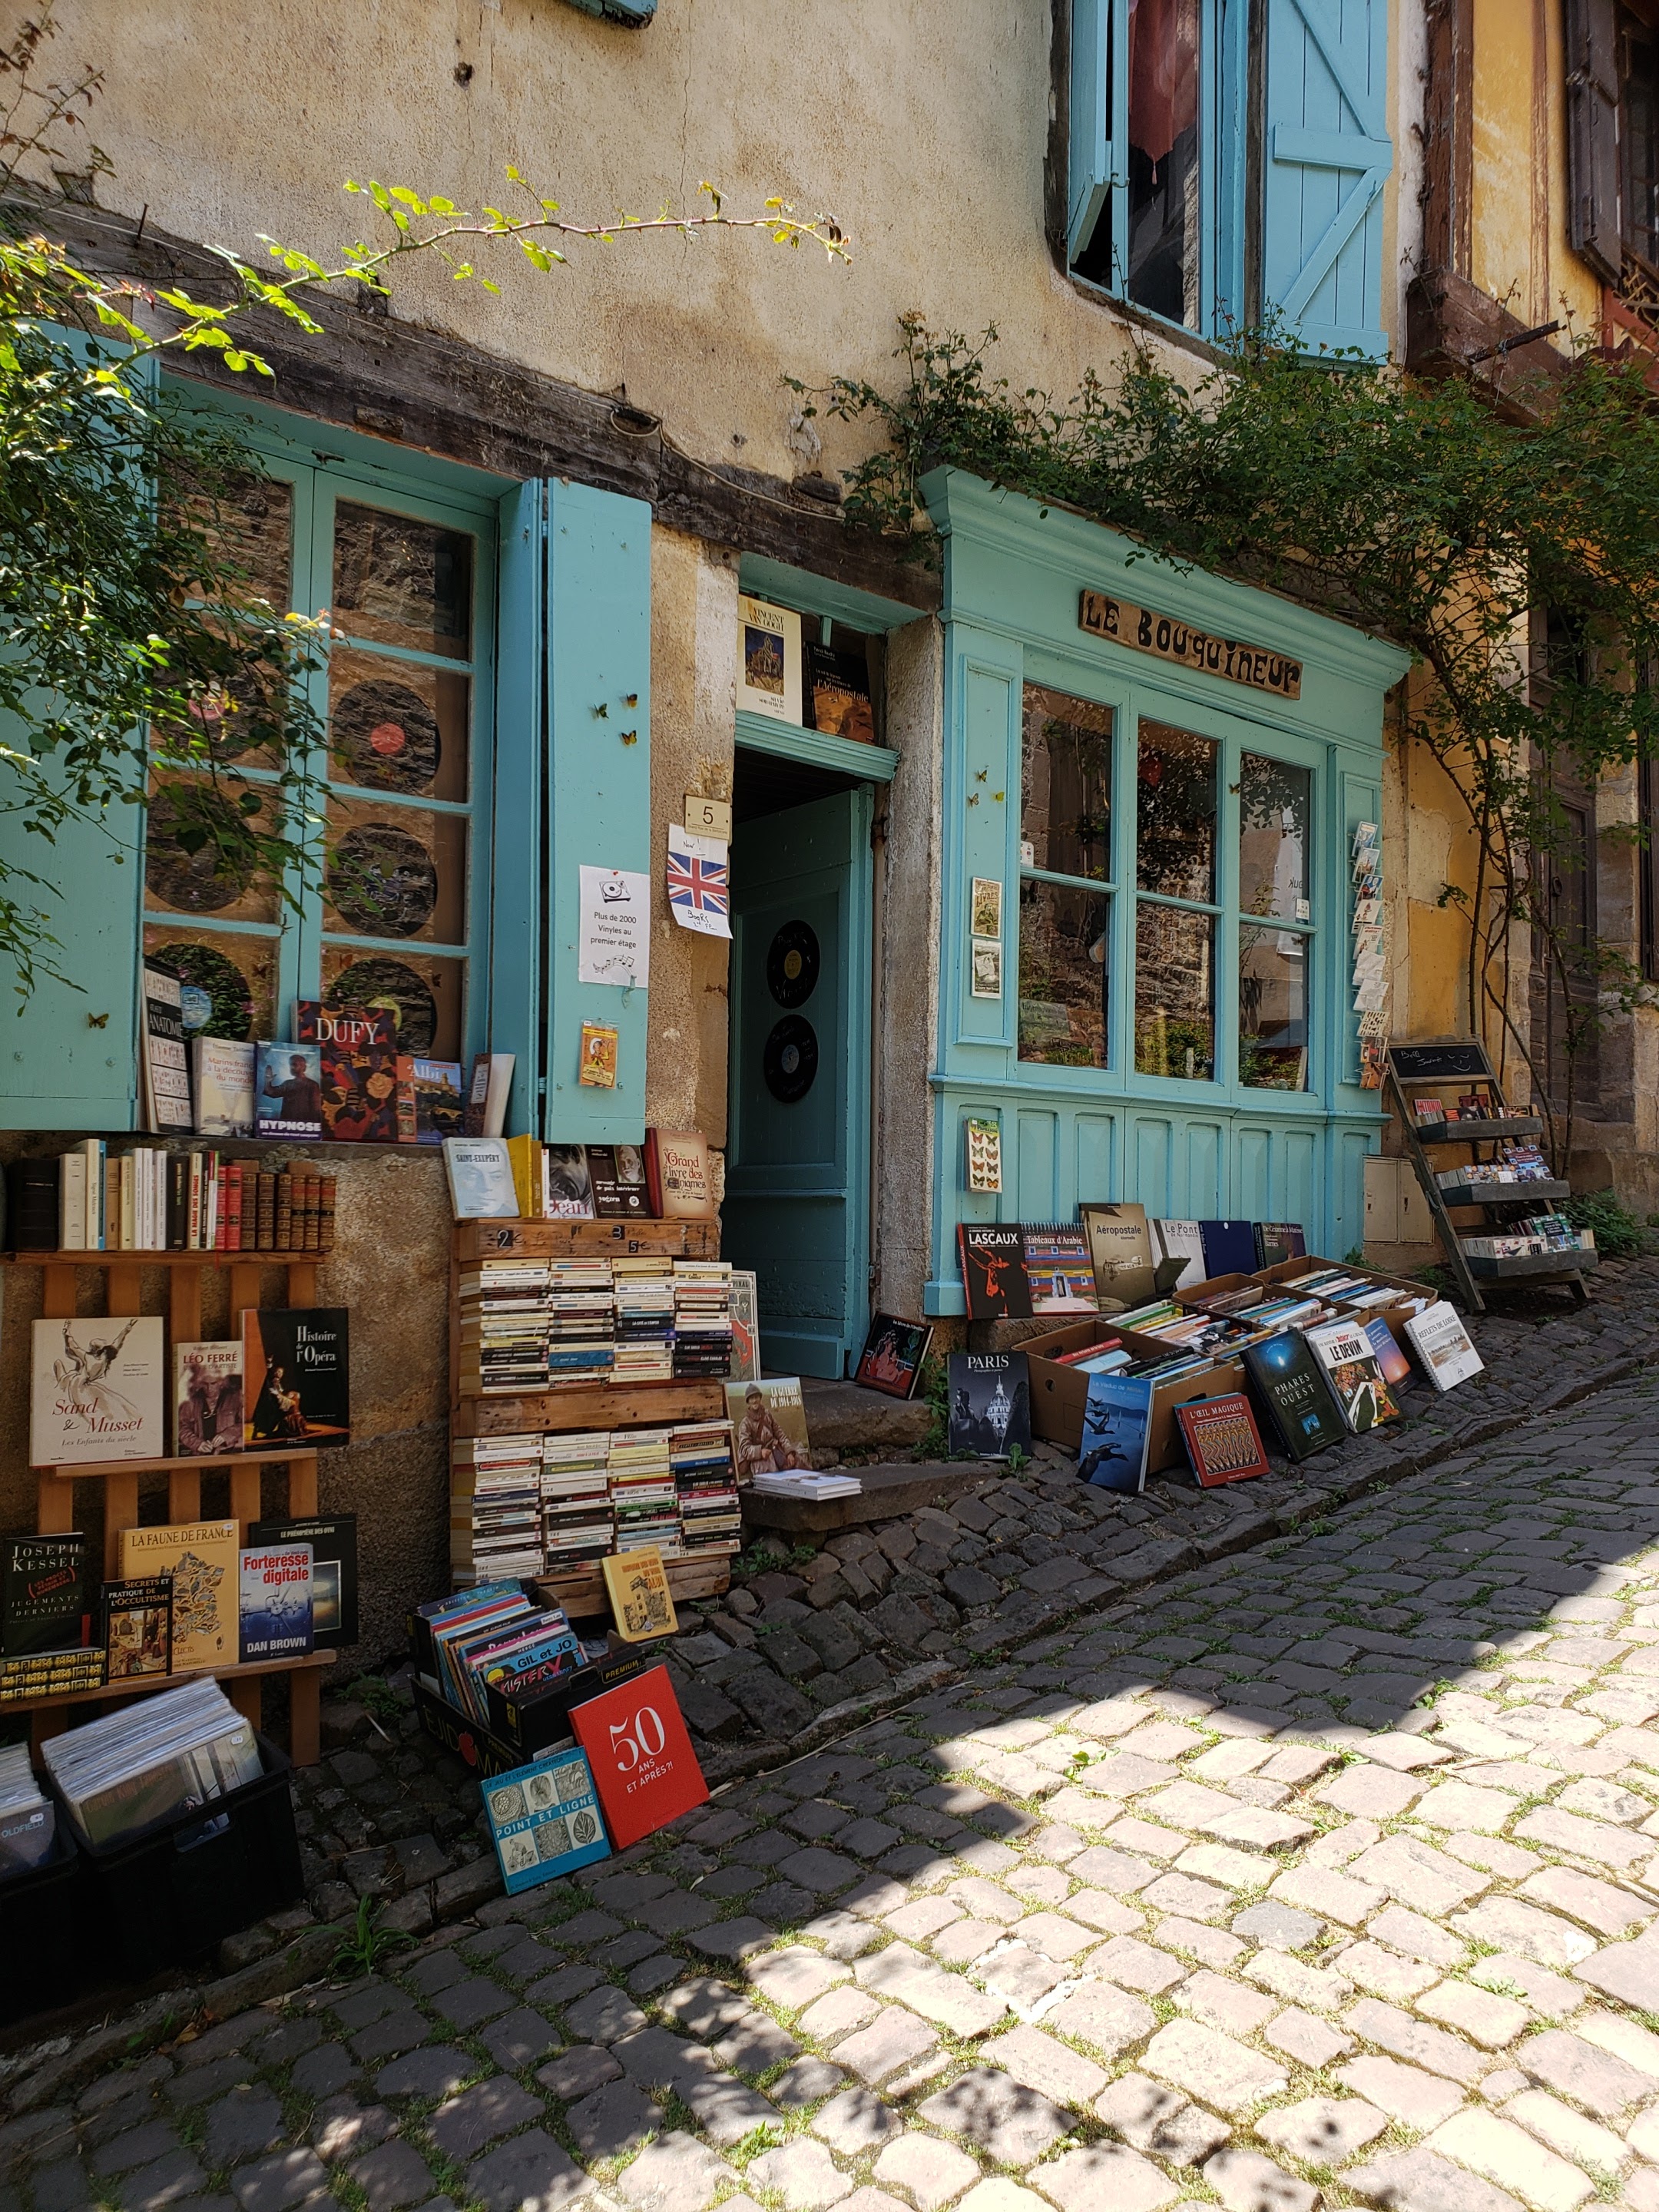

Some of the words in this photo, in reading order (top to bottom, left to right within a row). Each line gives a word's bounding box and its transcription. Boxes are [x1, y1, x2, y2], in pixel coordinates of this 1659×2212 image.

[753, 606, 785, 624] VINCENT
[1085, 594, 1120, 635] LE
[749, 613, 761, 625] VAN
[763, 618, 784, 633] GOGH
[817, 678, 869, 703] l'Aéropostale
[702, 806, 714, 825] 5
[594, 911, 608, 921] Plus
[609, 912, 618, 922] de
[619, 914, 637, 924] 2000
[598, 924, 622, 935] Vinyles
[623, 927, 632, 935] au
[591, 938, 617, 948] premier
[618, 939, 637, 949] étage
[316, 1018, 380, 1045] DUFY
[208, 1057, 233, 1066] Marins
[259, 1119, 322, 1131] HYPNOSE
[455, 1154, 501, 1163] SAINT-EXUPÉRY
[667, 1152, 700, 1167] Grand
[668, 1165, 687, 1179] livre
[688, 1167, 704, 1180] des
[191, 1174, 200, 1197] SONGES
[549, 1198, 590, 1214] Jean
[1096, 1225, 1142, 1236] Aéropostale
[1164, 1224, 1176, 1233] Le
[1177, 1224, 1198, 1235] Pont
[969, 1233, 1019, 1245] LASCAUX
[1027, 1235, 1056, 1244] Tableaux
[1056, 1235, 1083, 1245] d'Arabie
[296, 1325, 337, 1342] Histoire
[1417, 1323, 1438, 1339] REFLETS
[1435, 1320, 1445, 1330] DE
[1442, 1314, 1457, 1326] LOIRE
[184, 1353, 204, 1364] LÉO
[207, 1350, 238, 1363] FERRÉ
[296, 1345, 336, 1366] l'Opéra
[1330, 1346, 1343, 1362] LE
[1338, 1339, 1364, 1359] DEVIN
[967, 1355, 1009, 1369] PARIS
[770, 1387, 778, 1397] LA
[778, 1386, 799, 1396] GUERRE
[1101, 1382, 1118, 1390] Viaduc
[1273, 1373, 1311, 1396] PHARES
[770, 1398, 778, 1408] DE
[778, 1396, 802, 1407] 1914-1918
[1280, 1383, 1315, 1406] OUEST
[52, 1397, 99, 1416] Sand
[1211, 1402, 1244, 1416] MAGIQUE
[62, 1419, 80, 1431] &
[86, 1417, 144, 1434] Musset
[77, 1437, 104, 1447] Enfants
[117, 1435, 137, 1443] siècle
[131, 1535, 145, 1547] LA
[147, 1531, 179, 1545] FAUNE
[180, 1529, 194, 1542] DE
[195, 1526, 234, 1541] FRANCE
[286, 1528, 314, 1538] PHÉNOMÈNE
[12, 1543, 79, 1560] JOSEPH
[12, 1556, 79, 1572] KESSEL
[243, 1554, 309, 1571] Forteresse
[124, 1579, 160, 1589] SECRETS
[263, 1567, 309, 1586] digitale
[11, 1594, 80, 1608] JUGEMENTS
[108, 1589, 144, 1598] PRATIQUE
[111, 1594, 170, 1607] L'OCCULTISME
[15, 1604, 75, 1617] DERNIERS
[247, 1640, 267, 1653] DAN
[270, 1636, 306, 1651] BROWN
[517, 1657, 538, 1669] GIL
[539, 1647, 554, 1661] et
[556, 1639, 572, 1653] JO
[605, 1659, 639, 1680] PREMIUM
[609, 1706, 666, 1772] 50
[638, 1757, 655, 1774] ANS
[626, 1780, 638, 1794] ET
[496, 1817, 532, 1839] POINT
[539, 1809, 553, 1823] ET
[559, 1794, 596, 1815] LIGNE
[1, 1820, 45, 1838] OLDFIELD
